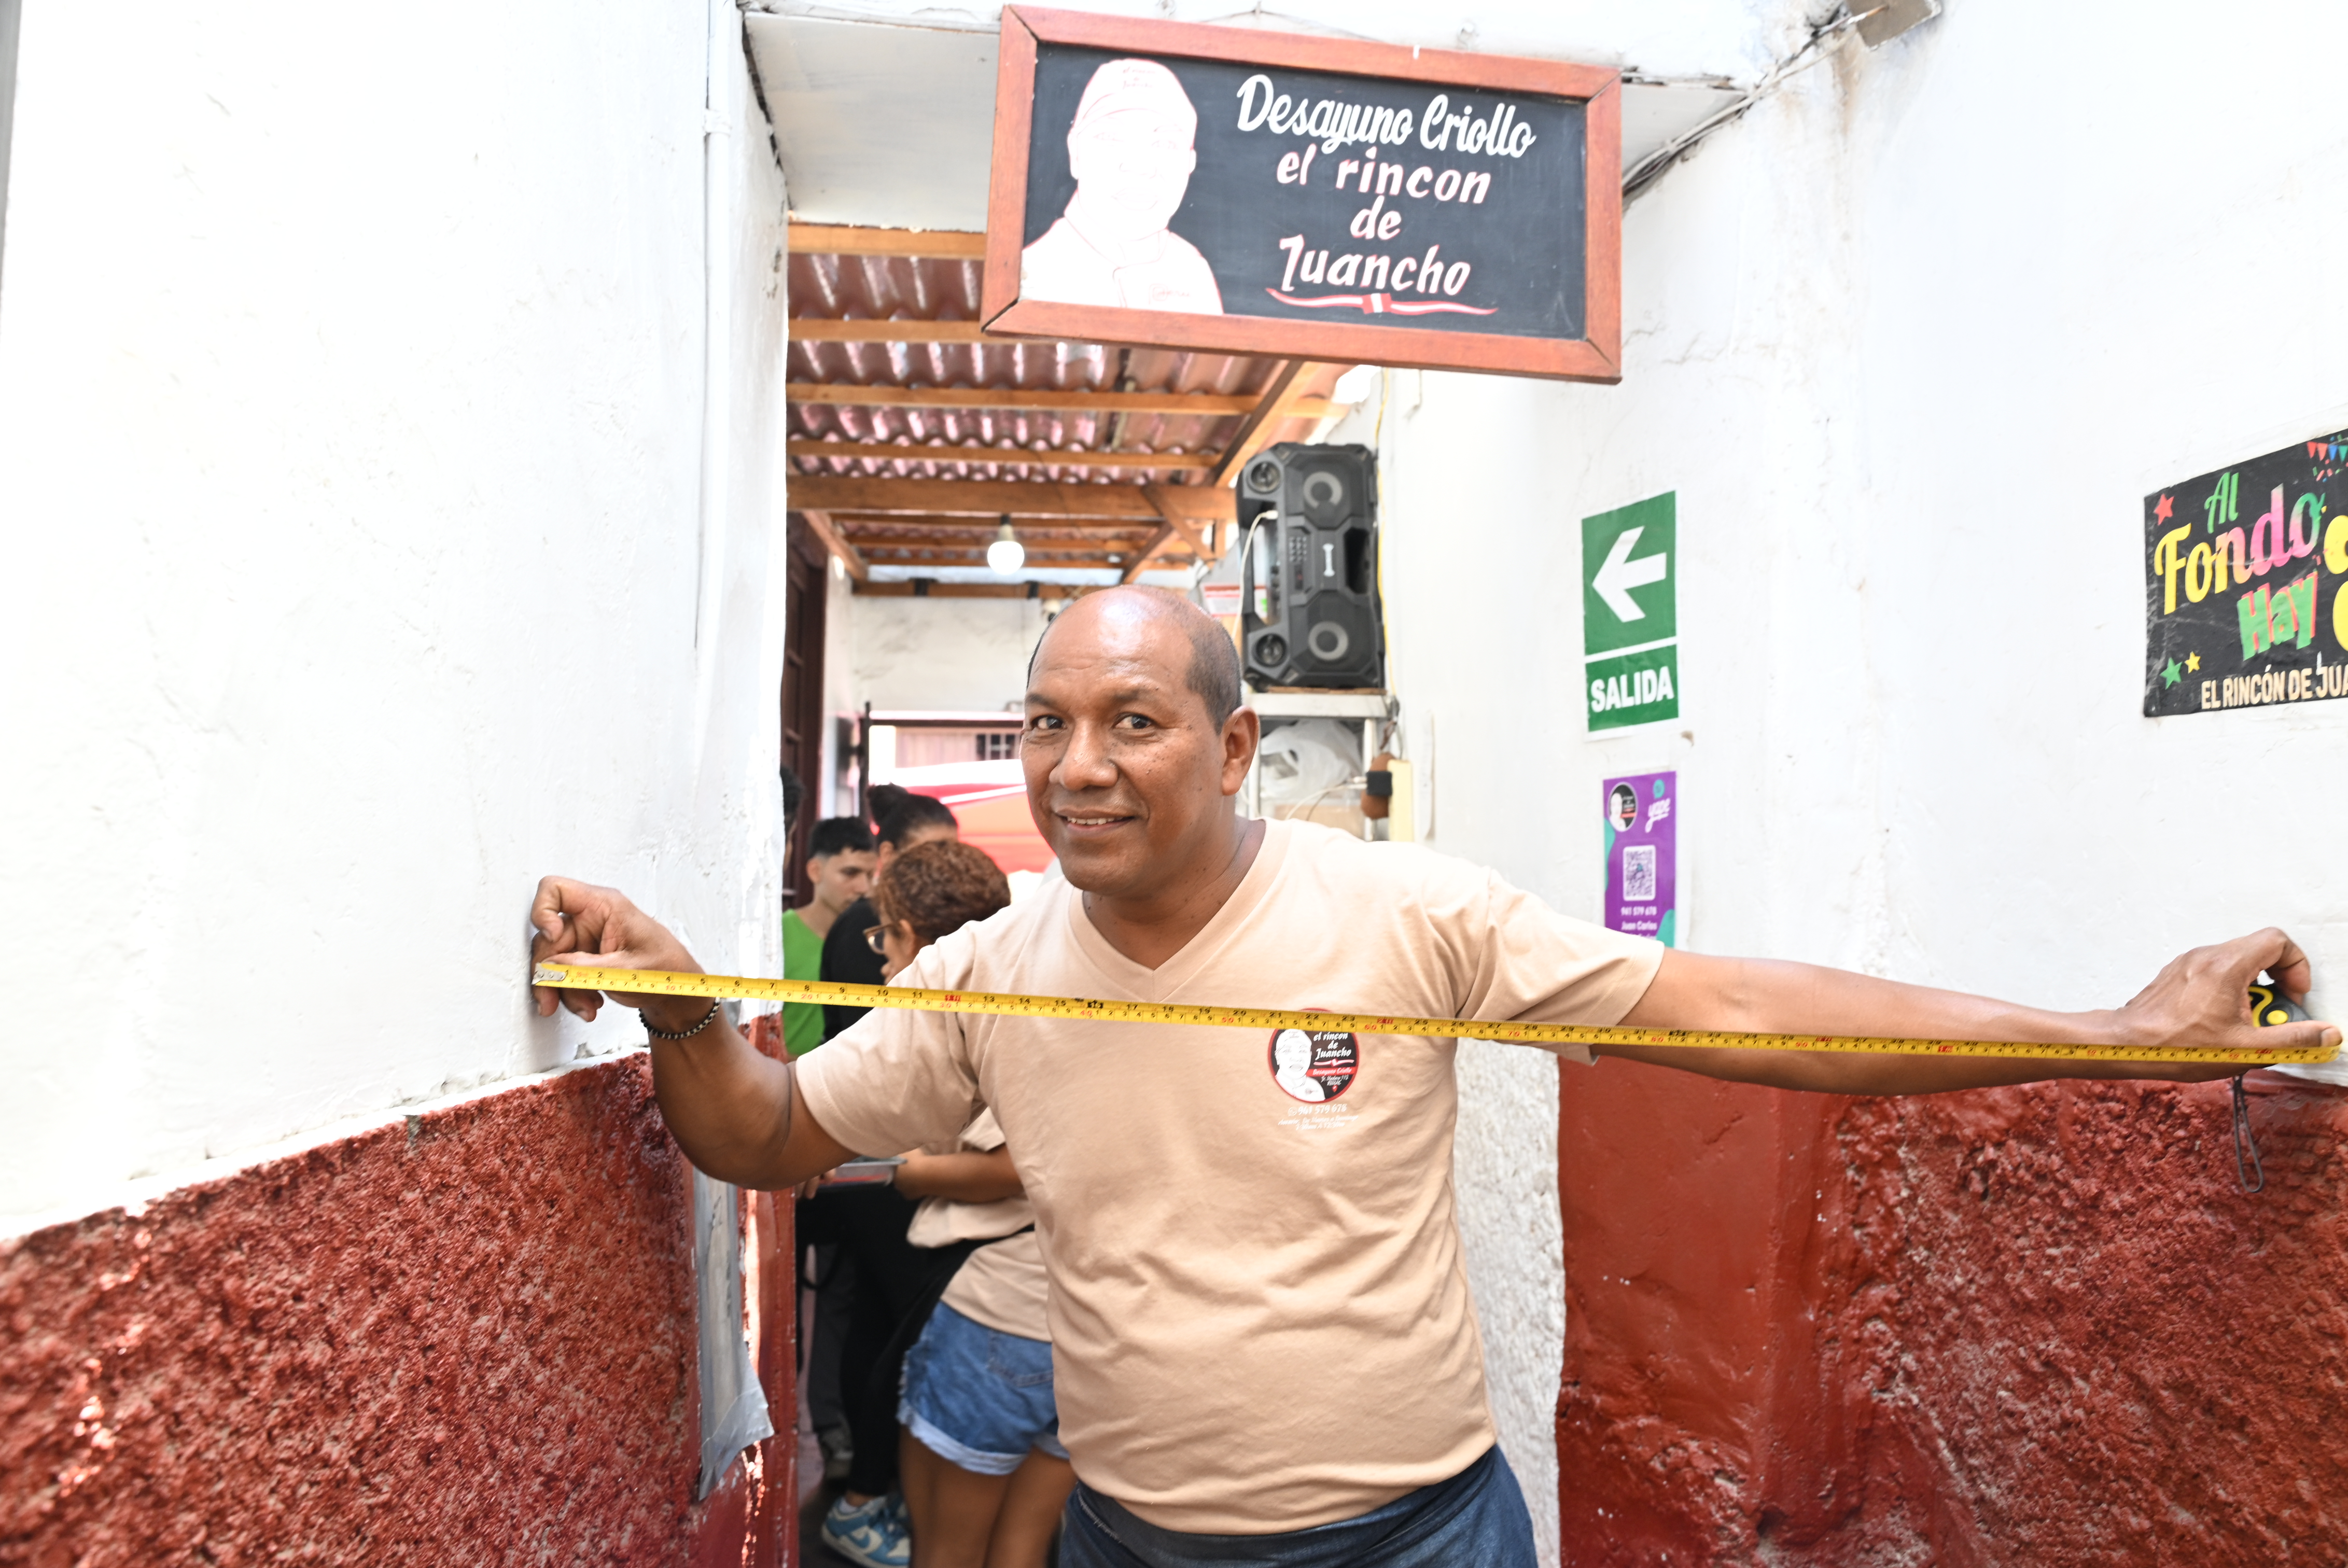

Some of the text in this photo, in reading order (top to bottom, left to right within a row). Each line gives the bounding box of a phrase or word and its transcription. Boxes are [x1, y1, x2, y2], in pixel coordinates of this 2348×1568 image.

[1237, 74, 1536, 158] Desayuno Criollo
[1277, 144, 1491, 204] el rincon
[1350, 196, 1402, 240] de
[1279, 235, 1471, 295] Juancho
[2204, 471, 2239, 534] Al
[2154, 482, 2325, 615] Fondo
[2237, 571, 2318, 661] Hay
[1590, 666, 1674, 713] SALIDA
[2201, 680, 2221, 709] EL
[2223, 664, 2286, 707] RINCÓN
[2288, 667, 2312, 701] DE
[565, 969, 569, 977] 1
[1313, 1032, 1348, 1041] el rincon
[1315, 1048, 1351, 1060] Juancho
[1327, 1040, 1338, 1049] de
[1298, 1103, 1347, 1115] 941 579 678
